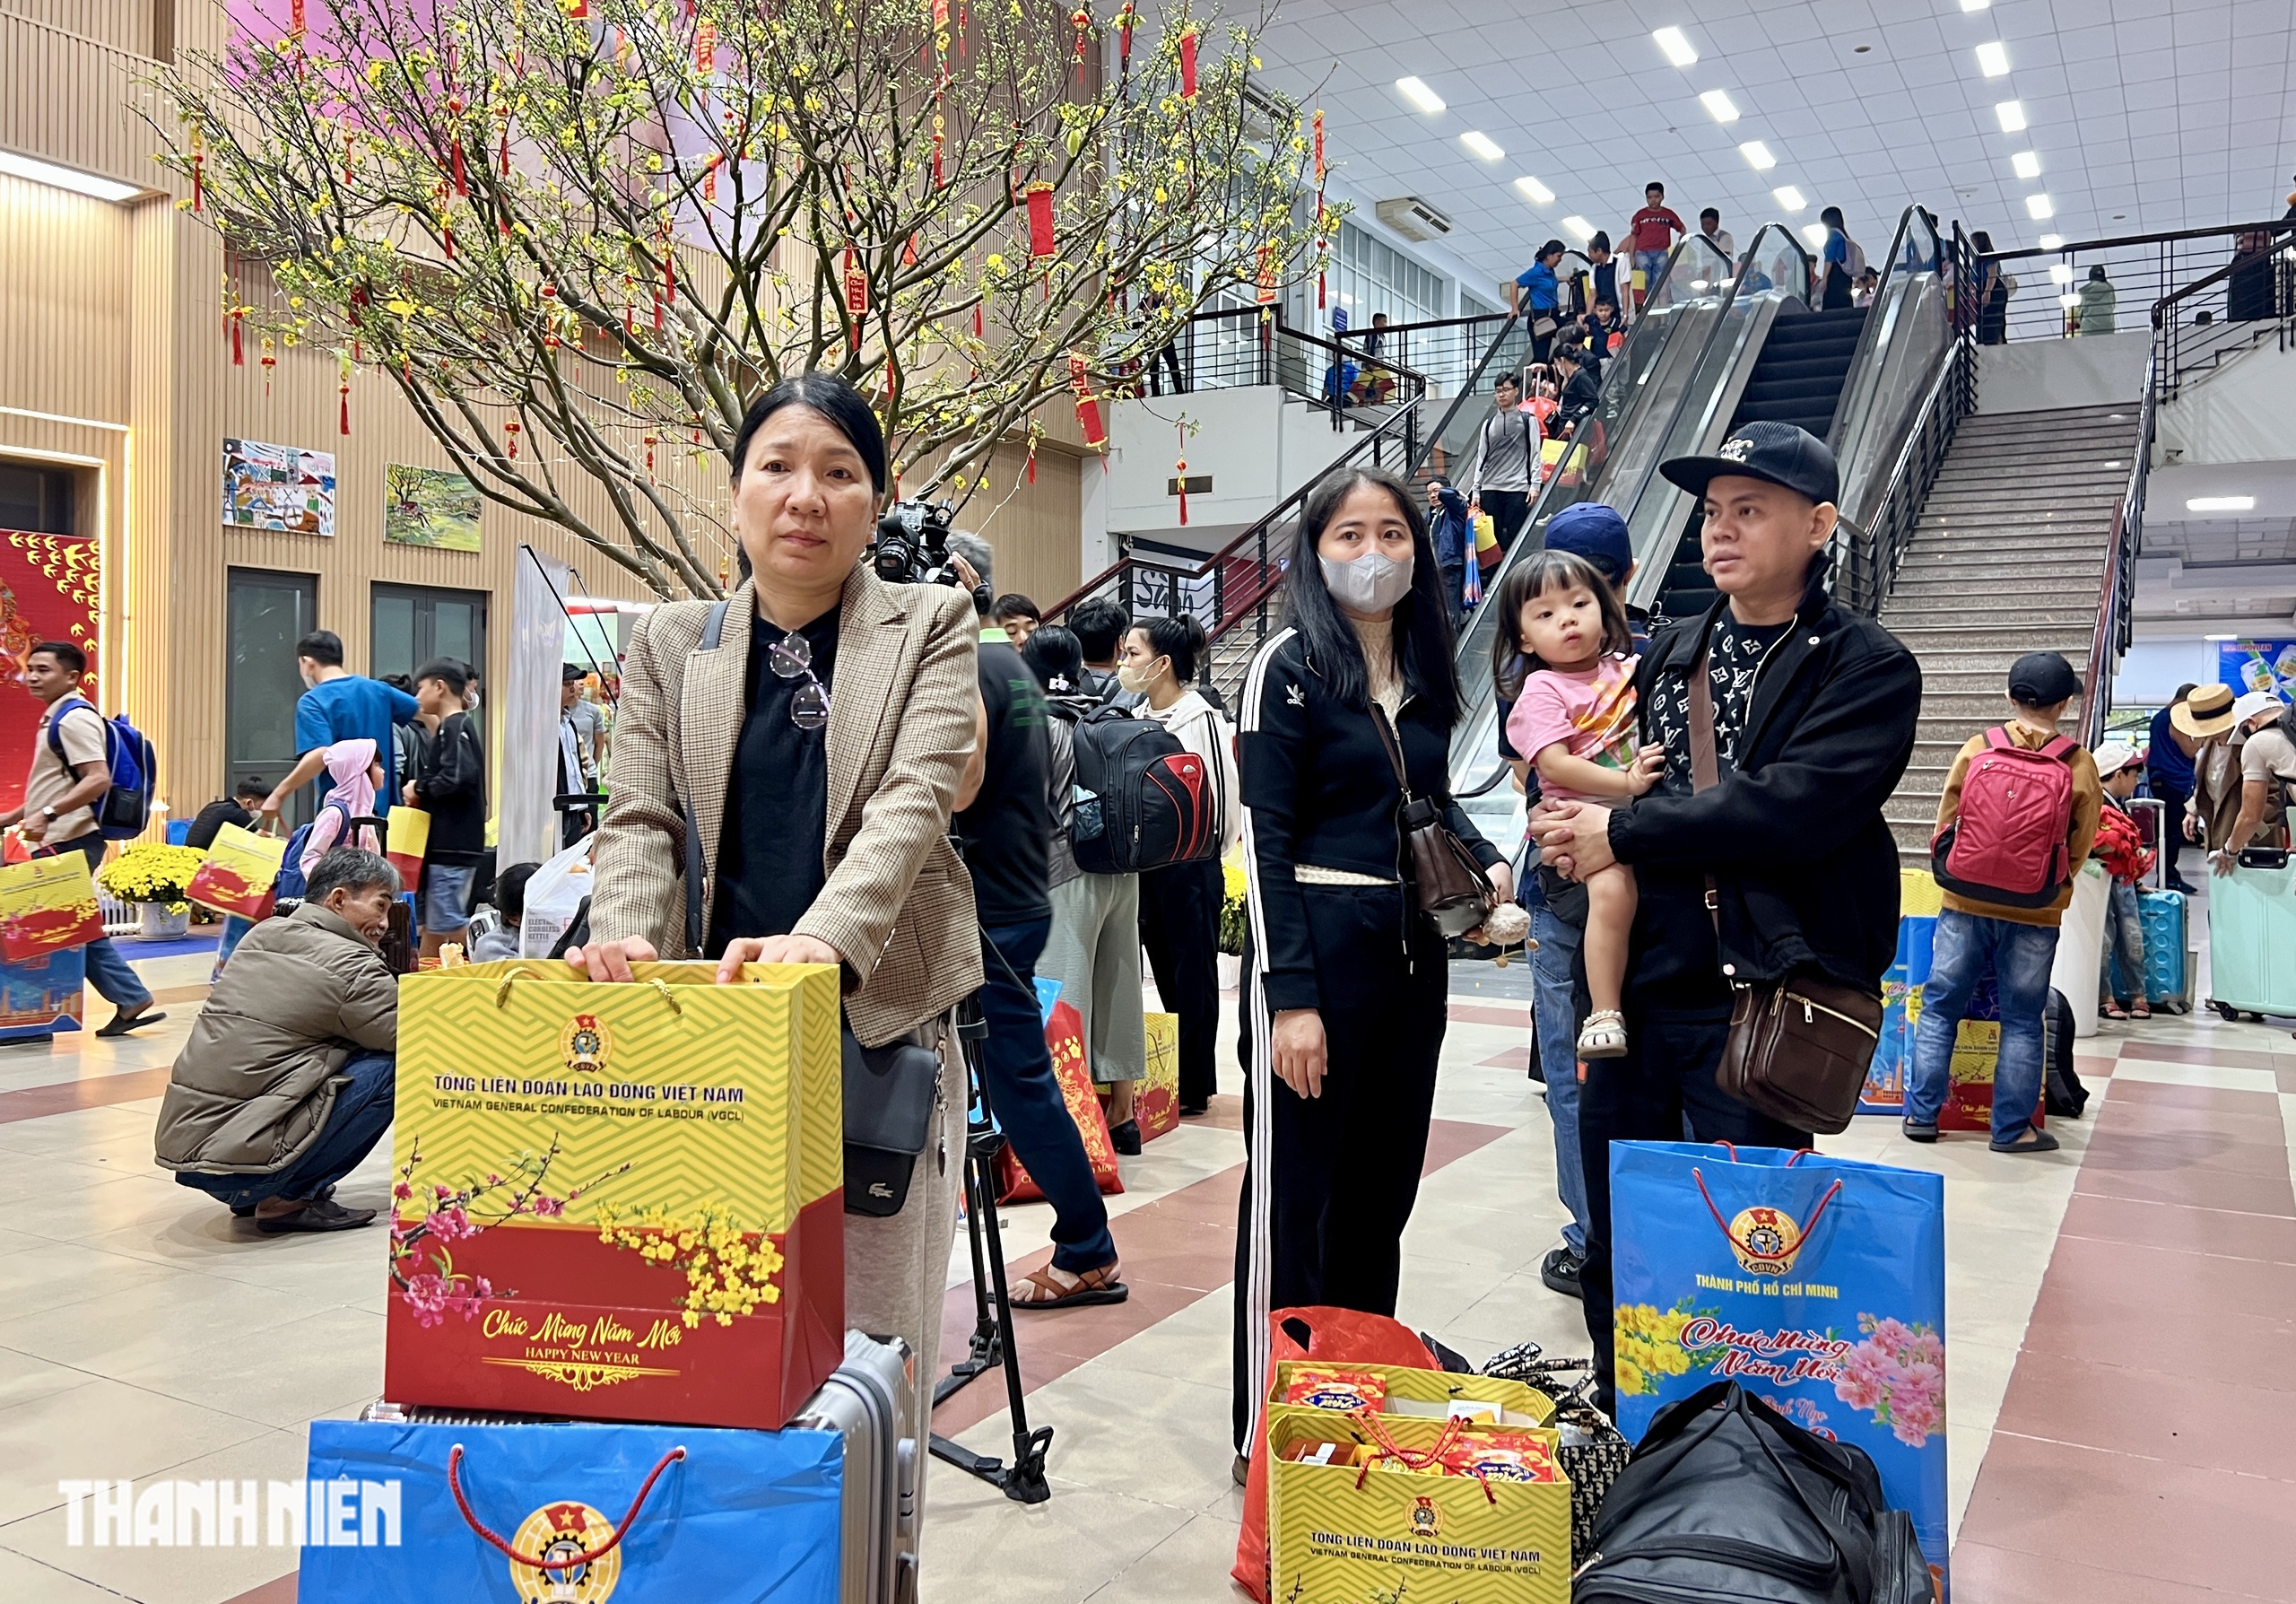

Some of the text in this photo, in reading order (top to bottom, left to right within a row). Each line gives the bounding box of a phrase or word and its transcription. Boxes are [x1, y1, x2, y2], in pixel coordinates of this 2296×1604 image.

[434, 1070, 744, 1104] TỔNG LIÊN ĐOÀN LAO ĐỘNG VIỆT NAM
[433, 1098, 744, 1122] VIETNAM GENERAL CONFEDERATION OF LABOUR (VGCL)
[1696, 1274, 1839, 1299] THÀNH PHỐ HỒ CHÍ MINH
[483, 1309, 683, 1351] Chúc Mừng Năm Mới
[1680, 1317, 1853, 1360] Chúc Mừng
[526, 1347, 639, 1364] HAPPY NEW YEAR
[1710, 1348, 1857, 1387] Năm Mới
[1310, 1547, 1347, 1558] VIETNAM
[1351, 1552, 1388, 1563] GENERAL
[1391, 1556, 1461, 1569] CONFEDERATION
[1478, 1564, 1512, 1572] LABOUR
[1311, 1530, 1343, 1545] TỔNG
[1347, 1534, 1373, 1548] LIÊN
[1415, 1543, 1438, 1556] LAO
[1481, 1547, 1507, 1561] VIỆT
[1510, 1550, 1540, 1562] NAM
